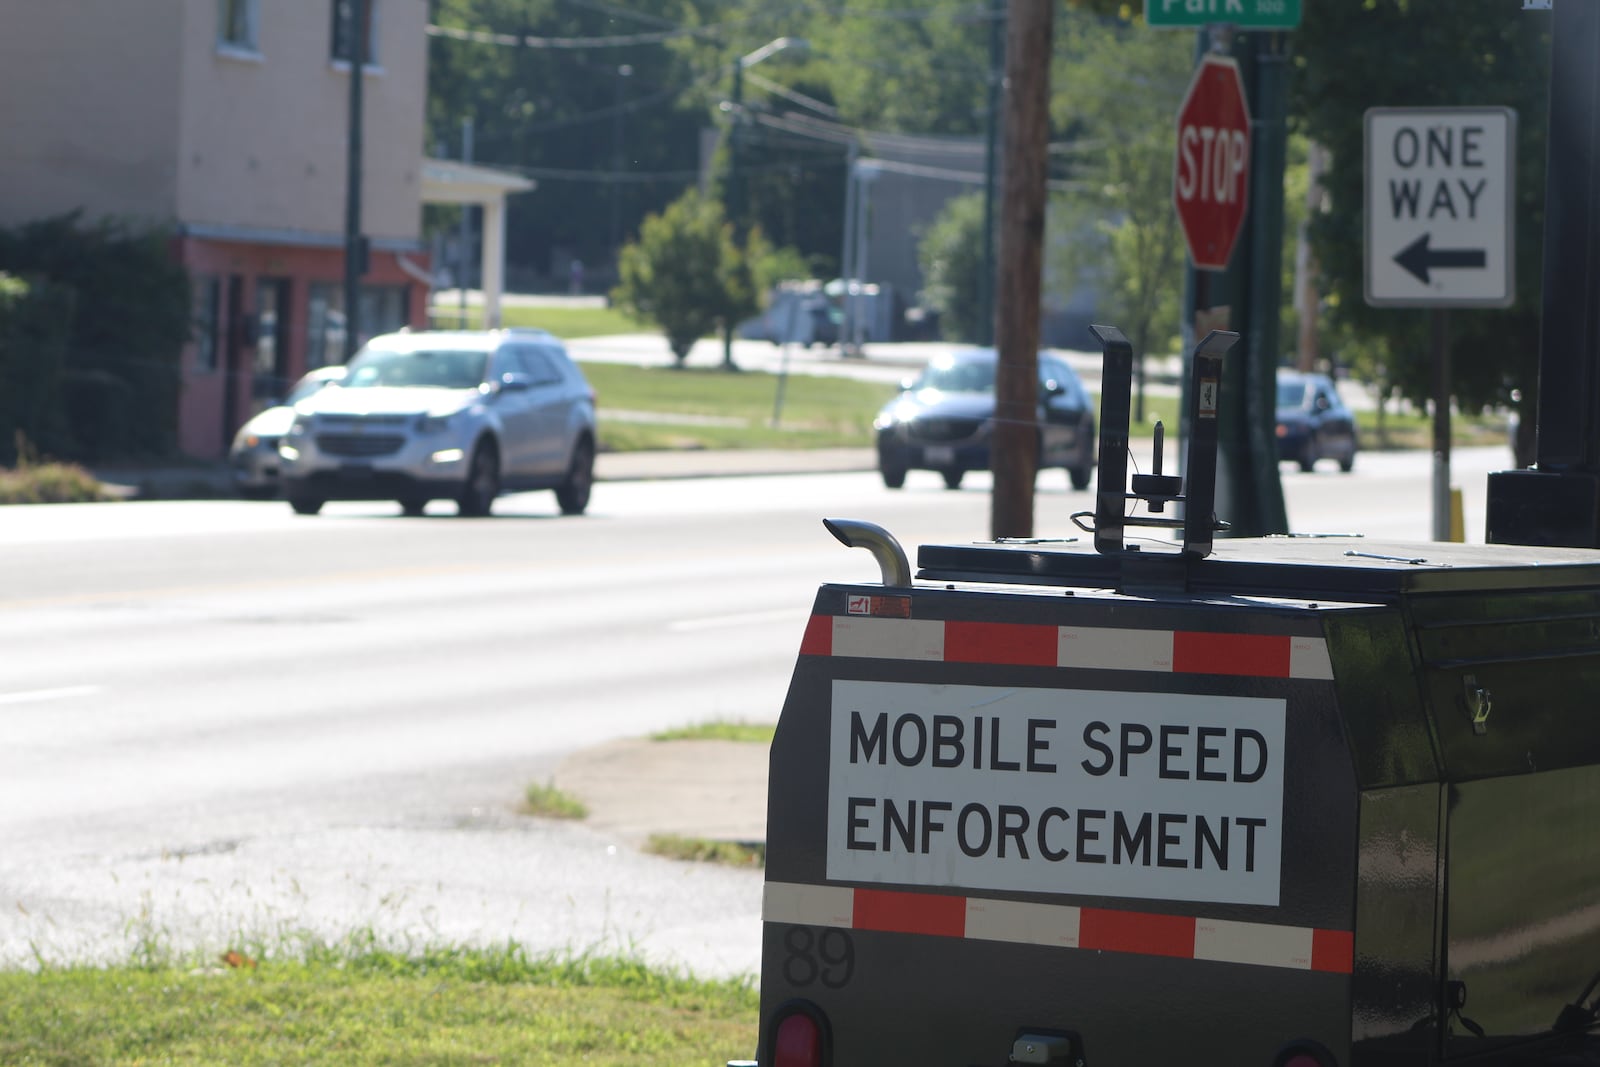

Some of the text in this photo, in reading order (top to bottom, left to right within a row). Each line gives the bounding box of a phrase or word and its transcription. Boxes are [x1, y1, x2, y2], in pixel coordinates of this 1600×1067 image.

[1179, 125, 1248, 203] STOP
[1393, 126, 1484, 168] ONE
[1389, 178, 1486, 220] WAY
[849, 711, 1268, 783] MOBILE SPEED
[847, 797, 1267, 872] ENFORCEMENT
[783, 925, 855, 989] 89
